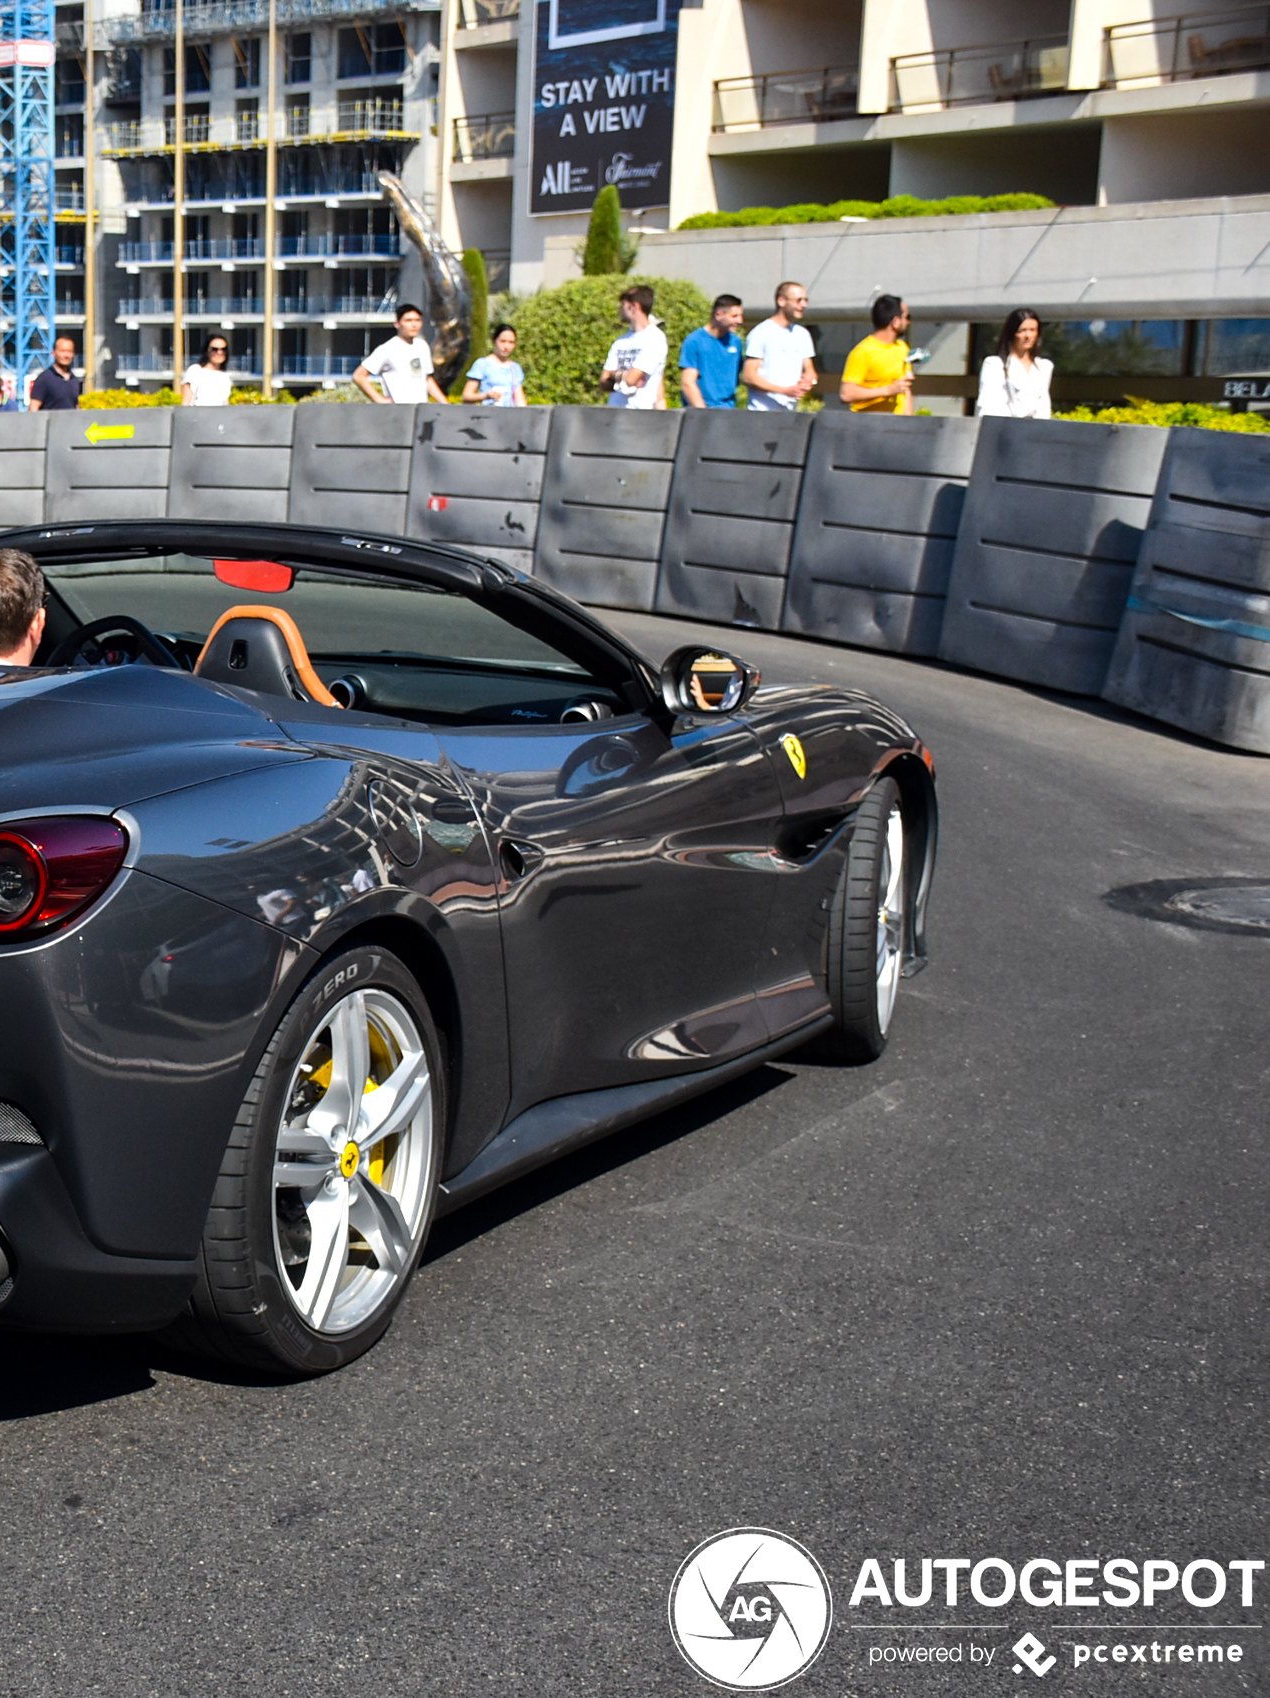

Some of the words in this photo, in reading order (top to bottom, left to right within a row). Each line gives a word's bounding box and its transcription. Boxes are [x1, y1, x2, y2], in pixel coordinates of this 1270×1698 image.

[540, 77, 598, 108] STAY
[604, 68, 670, 99] WITH
[559, 113, 577, 138] A
[583, 103, 647, 134] VIEW
[312, 963, 358, 1014] ZERO
